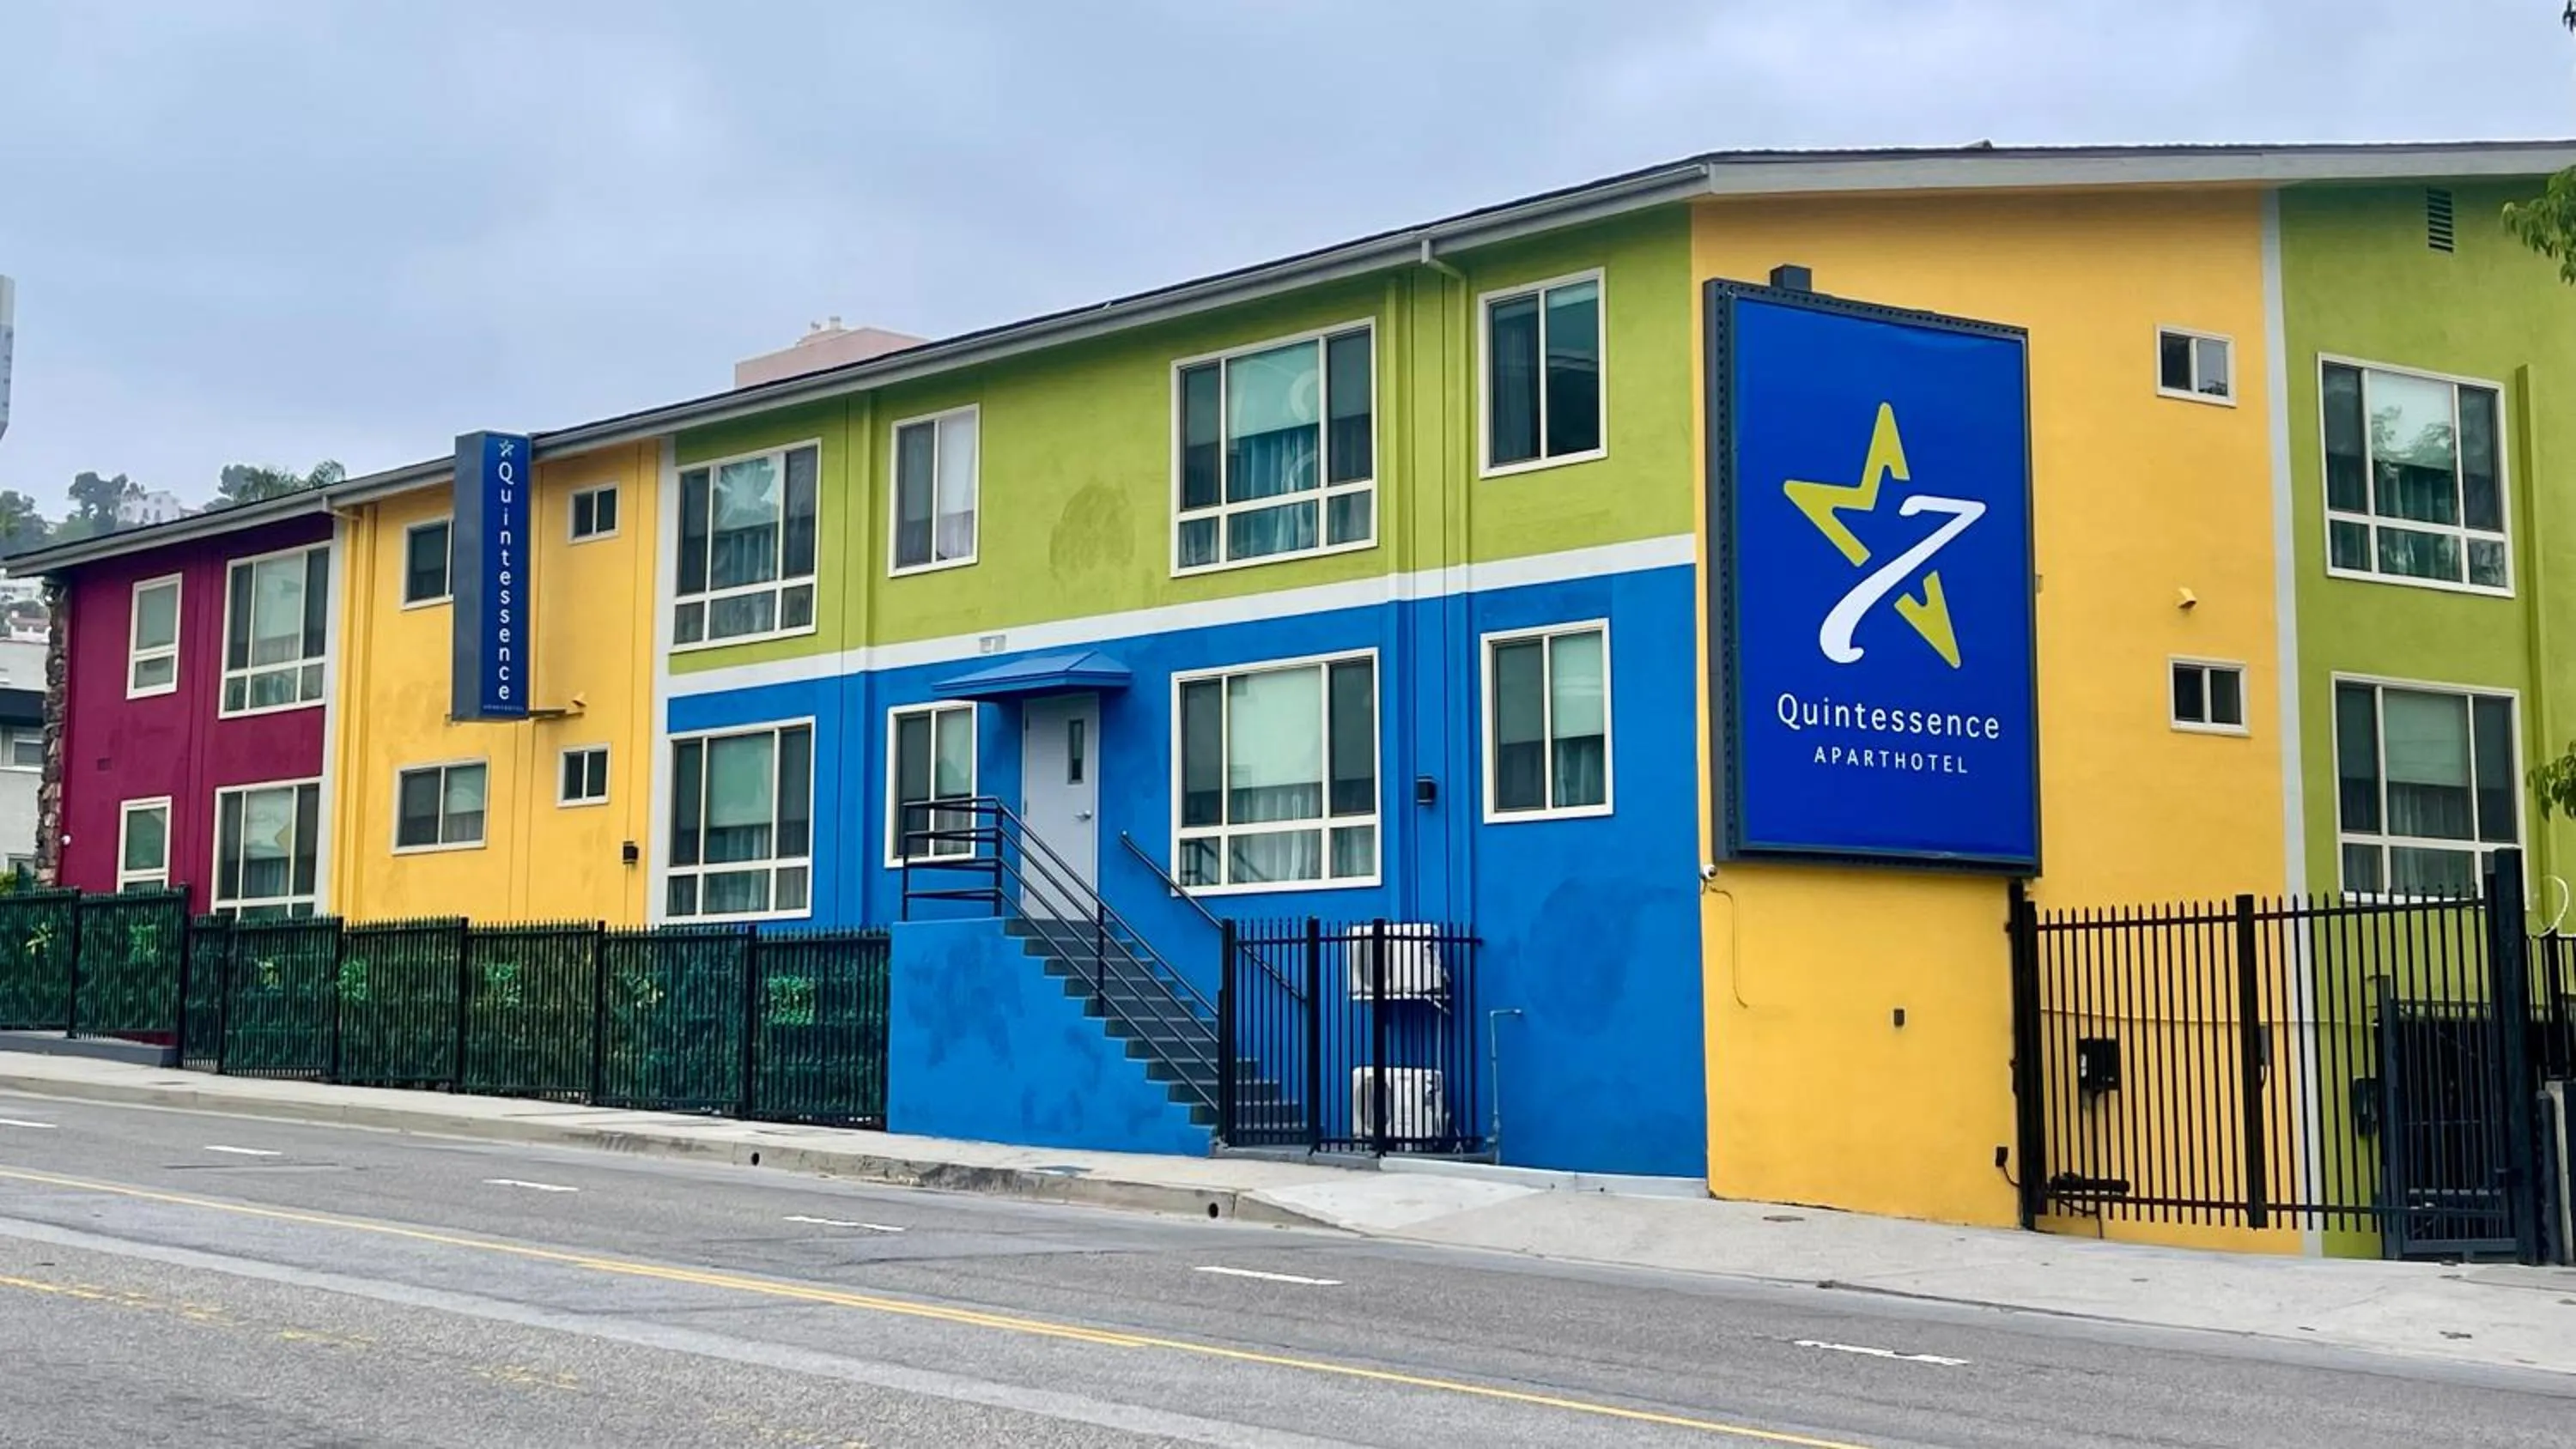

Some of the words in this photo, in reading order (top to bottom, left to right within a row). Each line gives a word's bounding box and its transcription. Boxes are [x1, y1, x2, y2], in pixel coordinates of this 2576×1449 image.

[497, 461, 514, 700] Quintessence
[1777, 693, 2000, 739] Quintessence
[1814, 745, 1968, 773] APARTHOTEL
